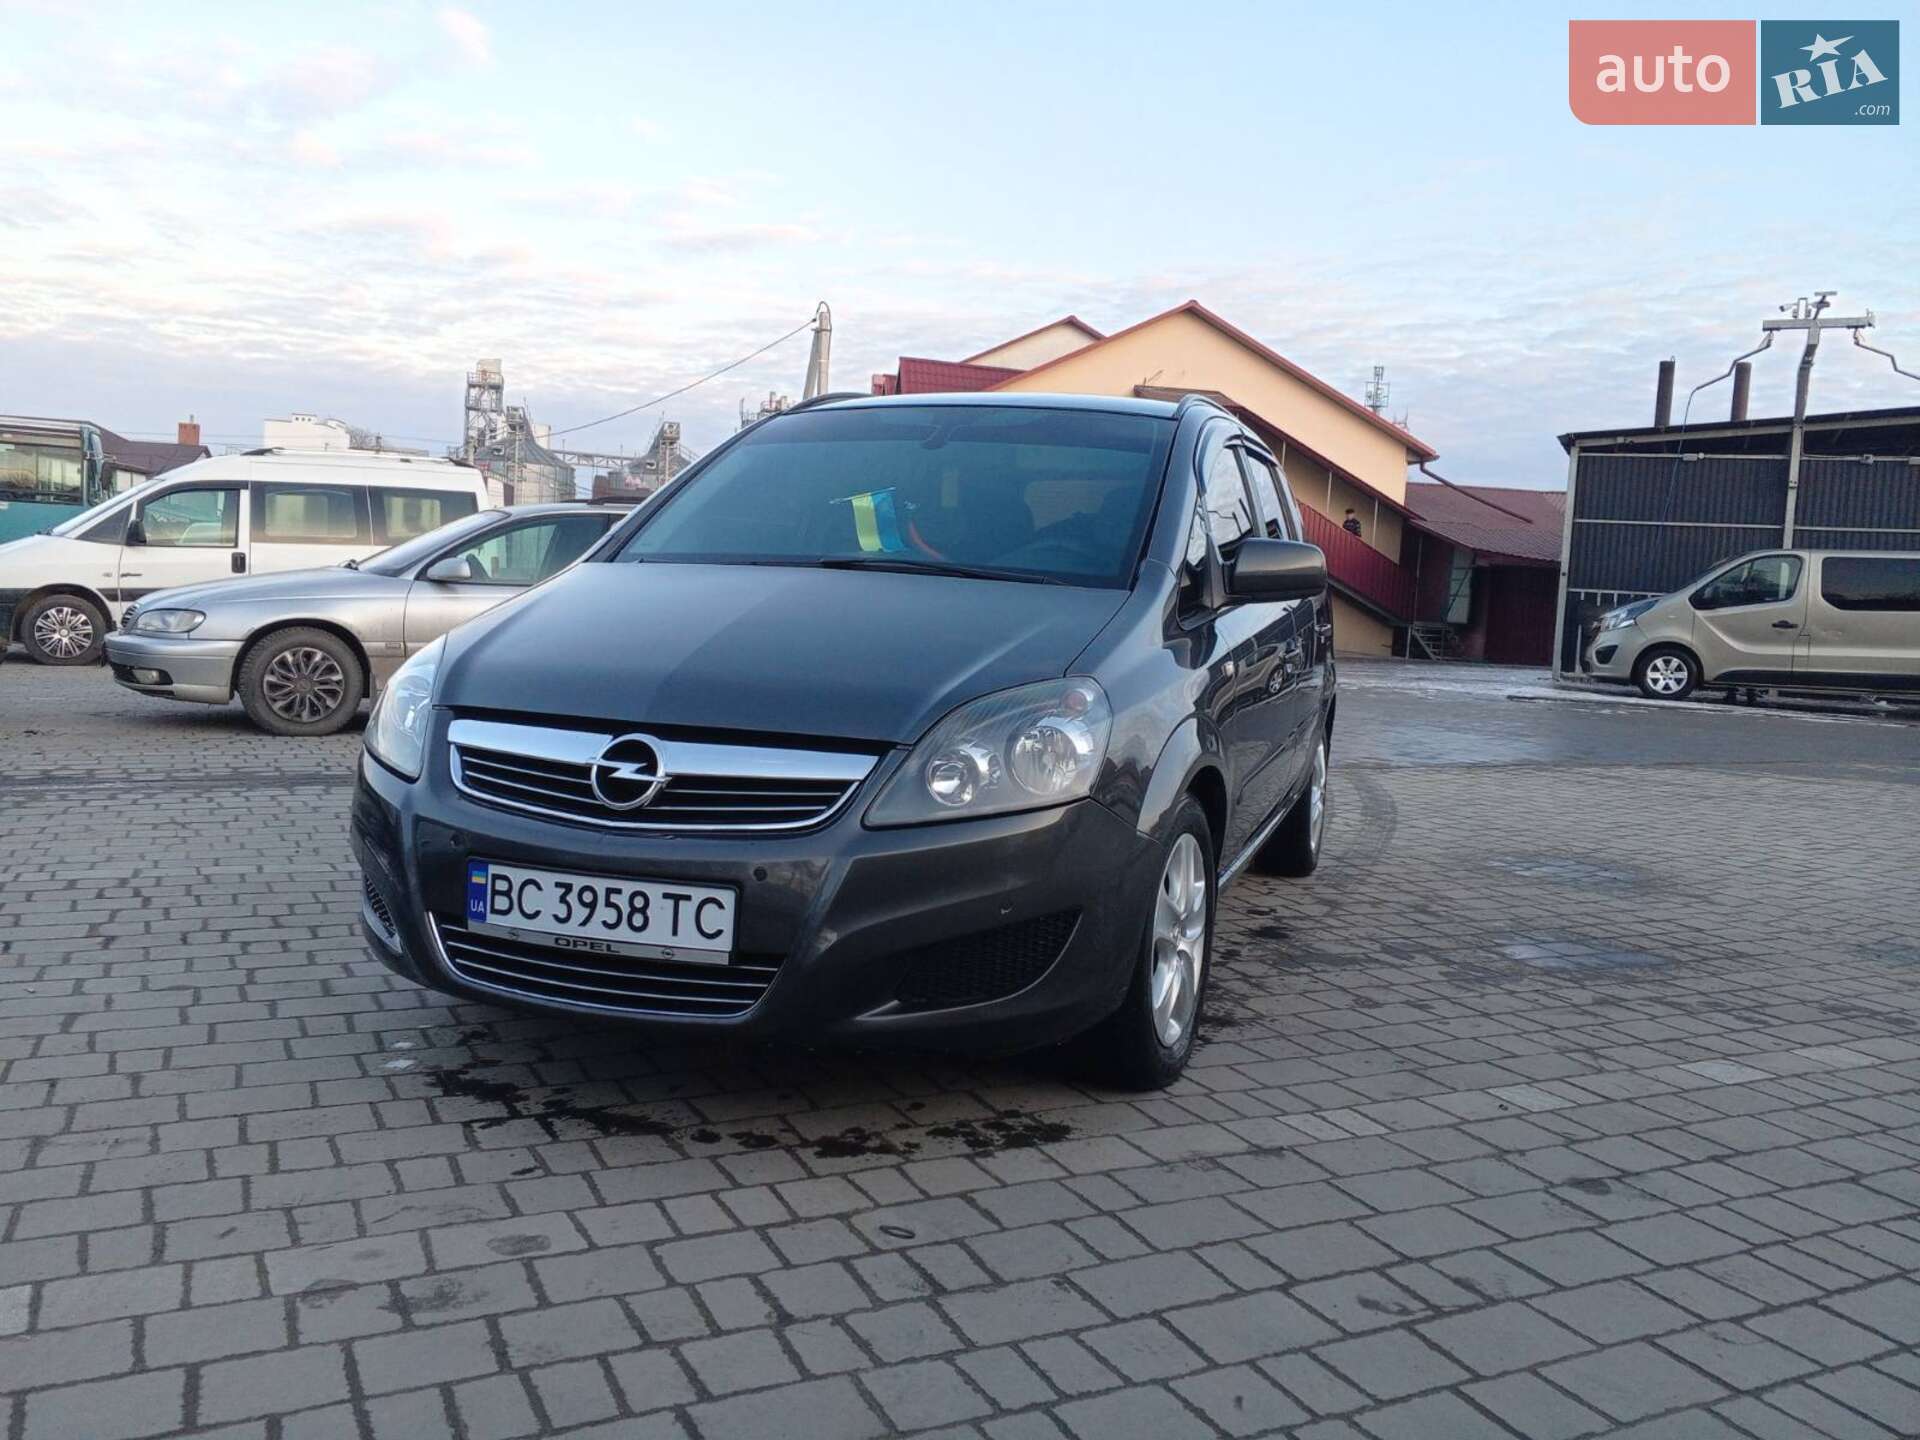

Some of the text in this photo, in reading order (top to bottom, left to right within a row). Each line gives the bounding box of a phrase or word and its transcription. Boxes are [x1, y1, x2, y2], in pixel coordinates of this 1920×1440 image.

[470, 900, 485, 913] UA
[490, 873, 726, 940] BC 3958 TC
[554, 936, 622, 954] OPEL
